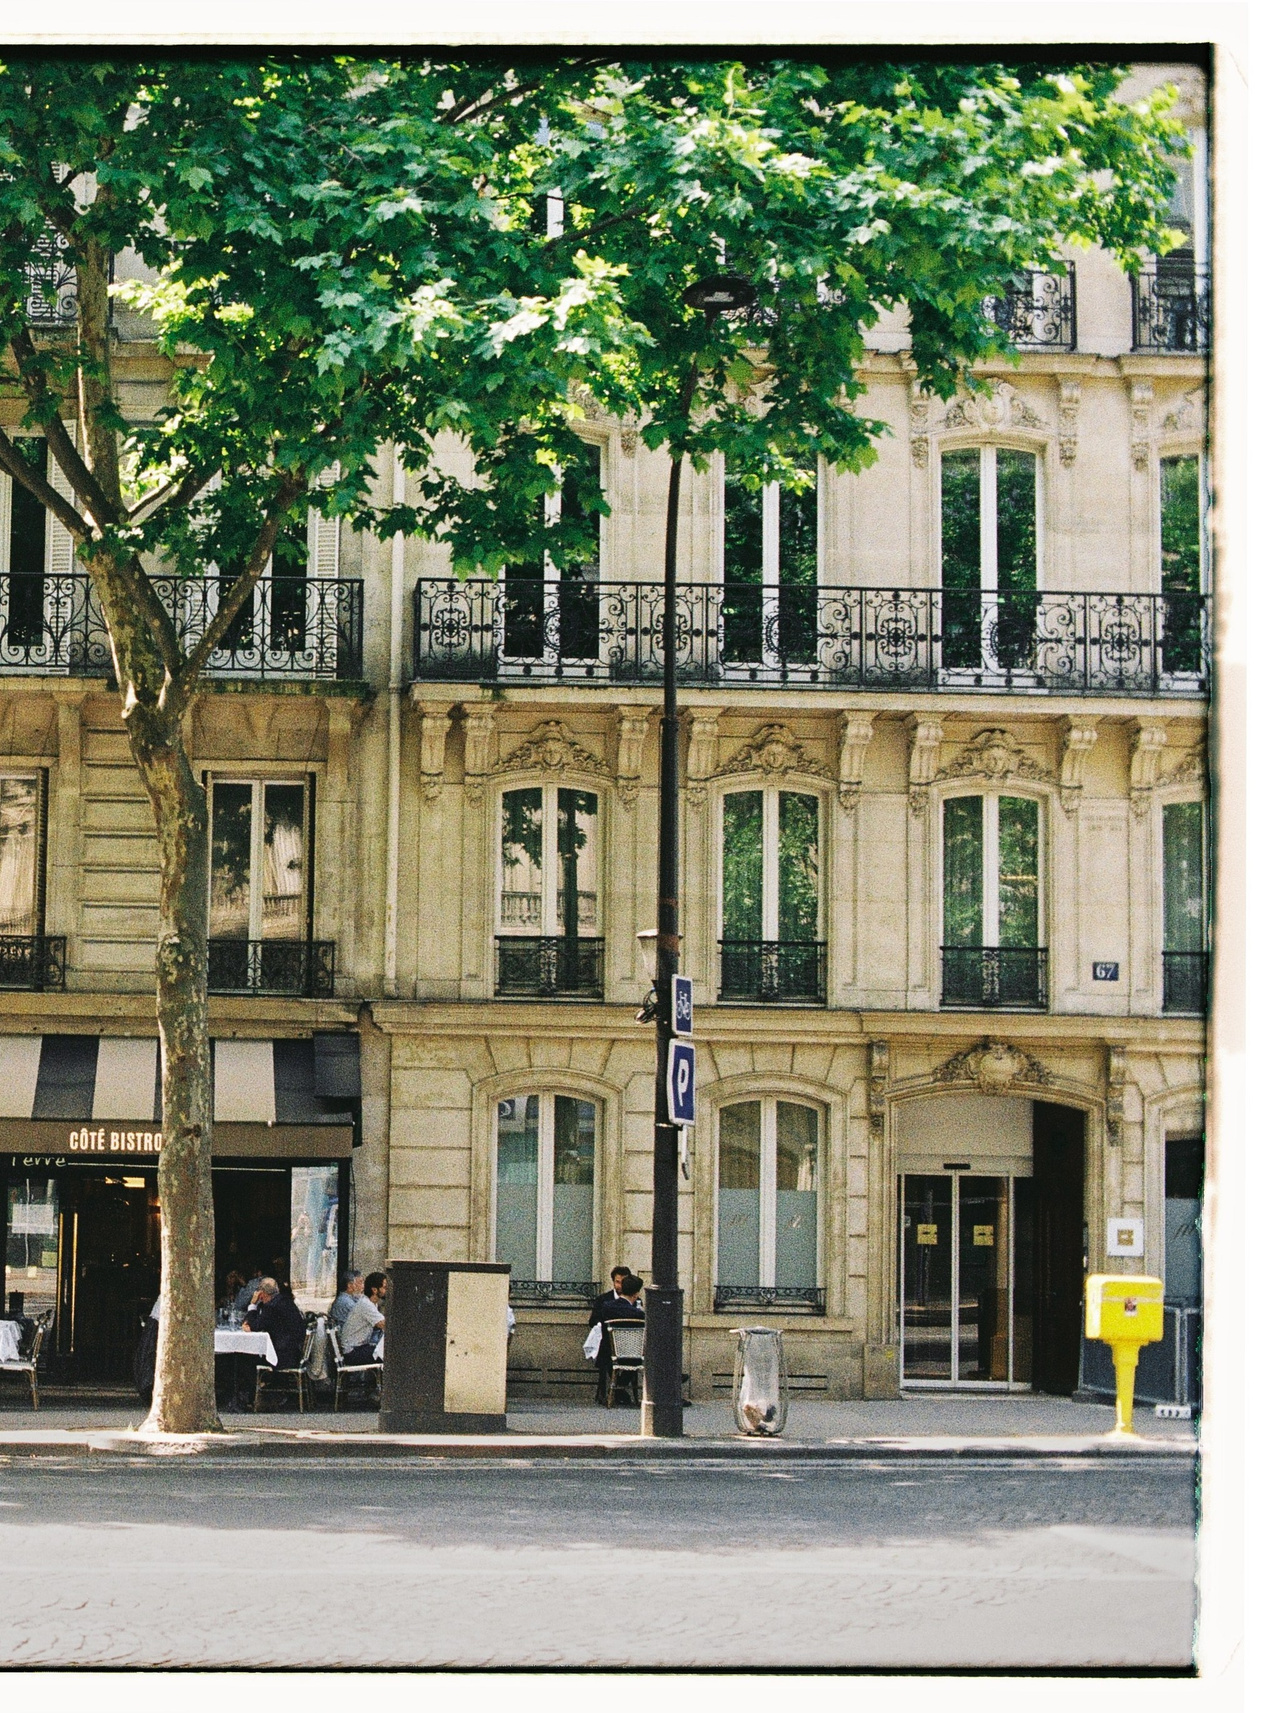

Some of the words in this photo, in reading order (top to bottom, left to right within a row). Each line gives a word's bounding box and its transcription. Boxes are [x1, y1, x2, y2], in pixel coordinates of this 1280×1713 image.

[1096, 963, 1115, 979] 67
[677, 1058, 690, 1107] P
[69, 1127, 105, 1151] CÔTÉ
[110, 1131, 162, 1152] BISTRO
